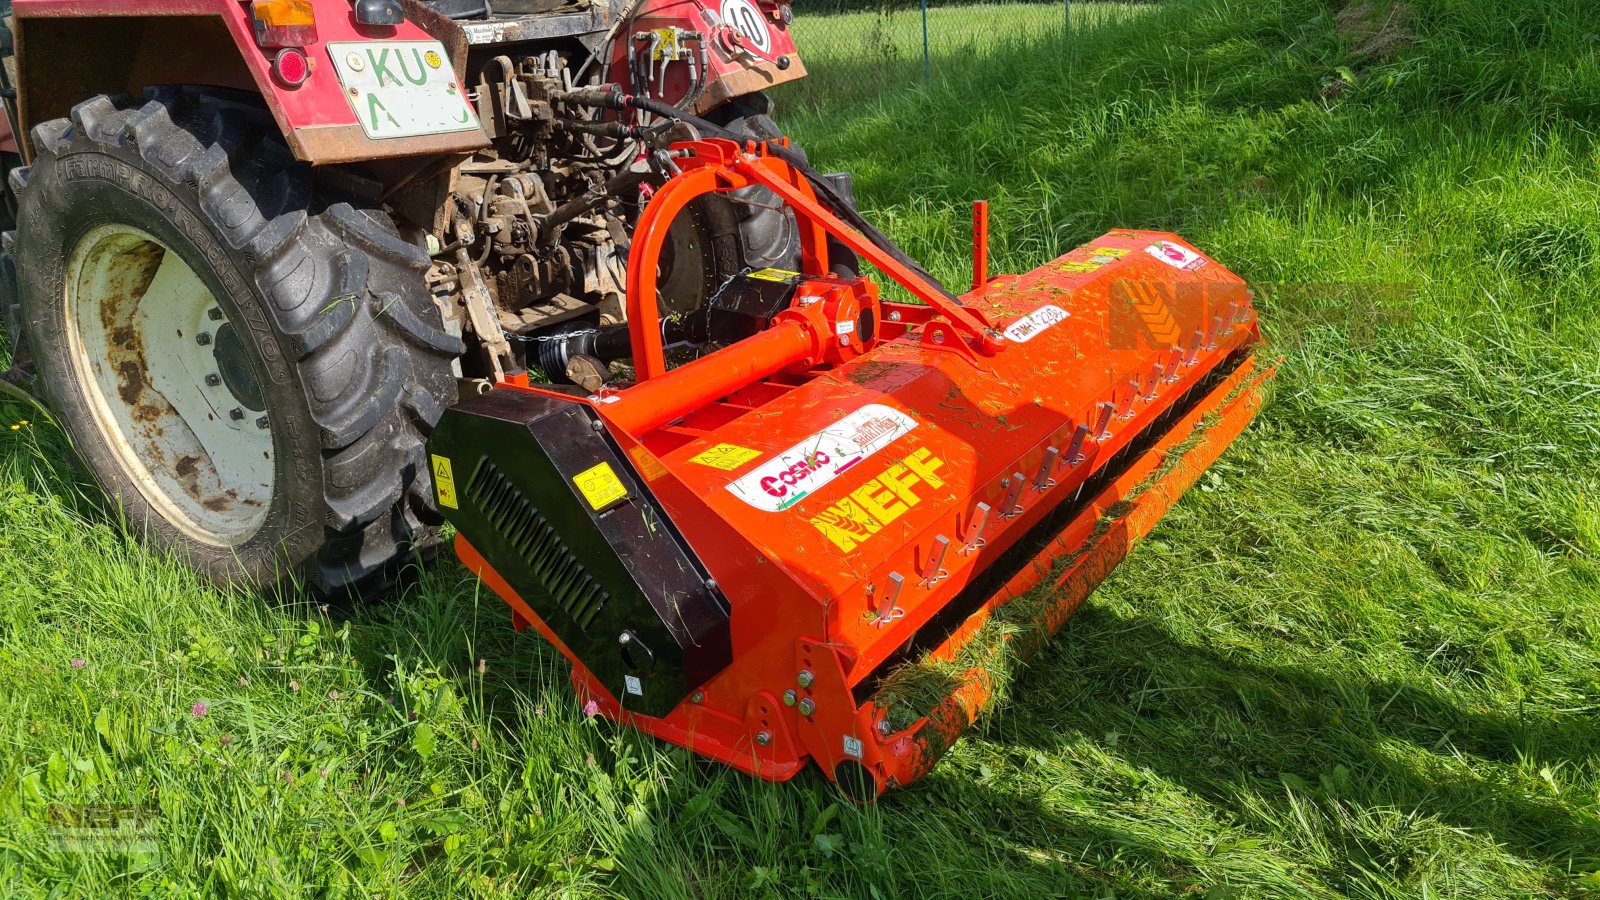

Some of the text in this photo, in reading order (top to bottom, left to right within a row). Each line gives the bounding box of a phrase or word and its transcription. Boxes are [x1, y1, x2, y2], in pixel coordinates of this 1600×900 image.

[729, 6, 764, 46] 40
[366, 48, 428, 88] KU
[65, 155, 281, 363] FarmPRO Radial 70
[808, 446, 945, 554] NEFF
